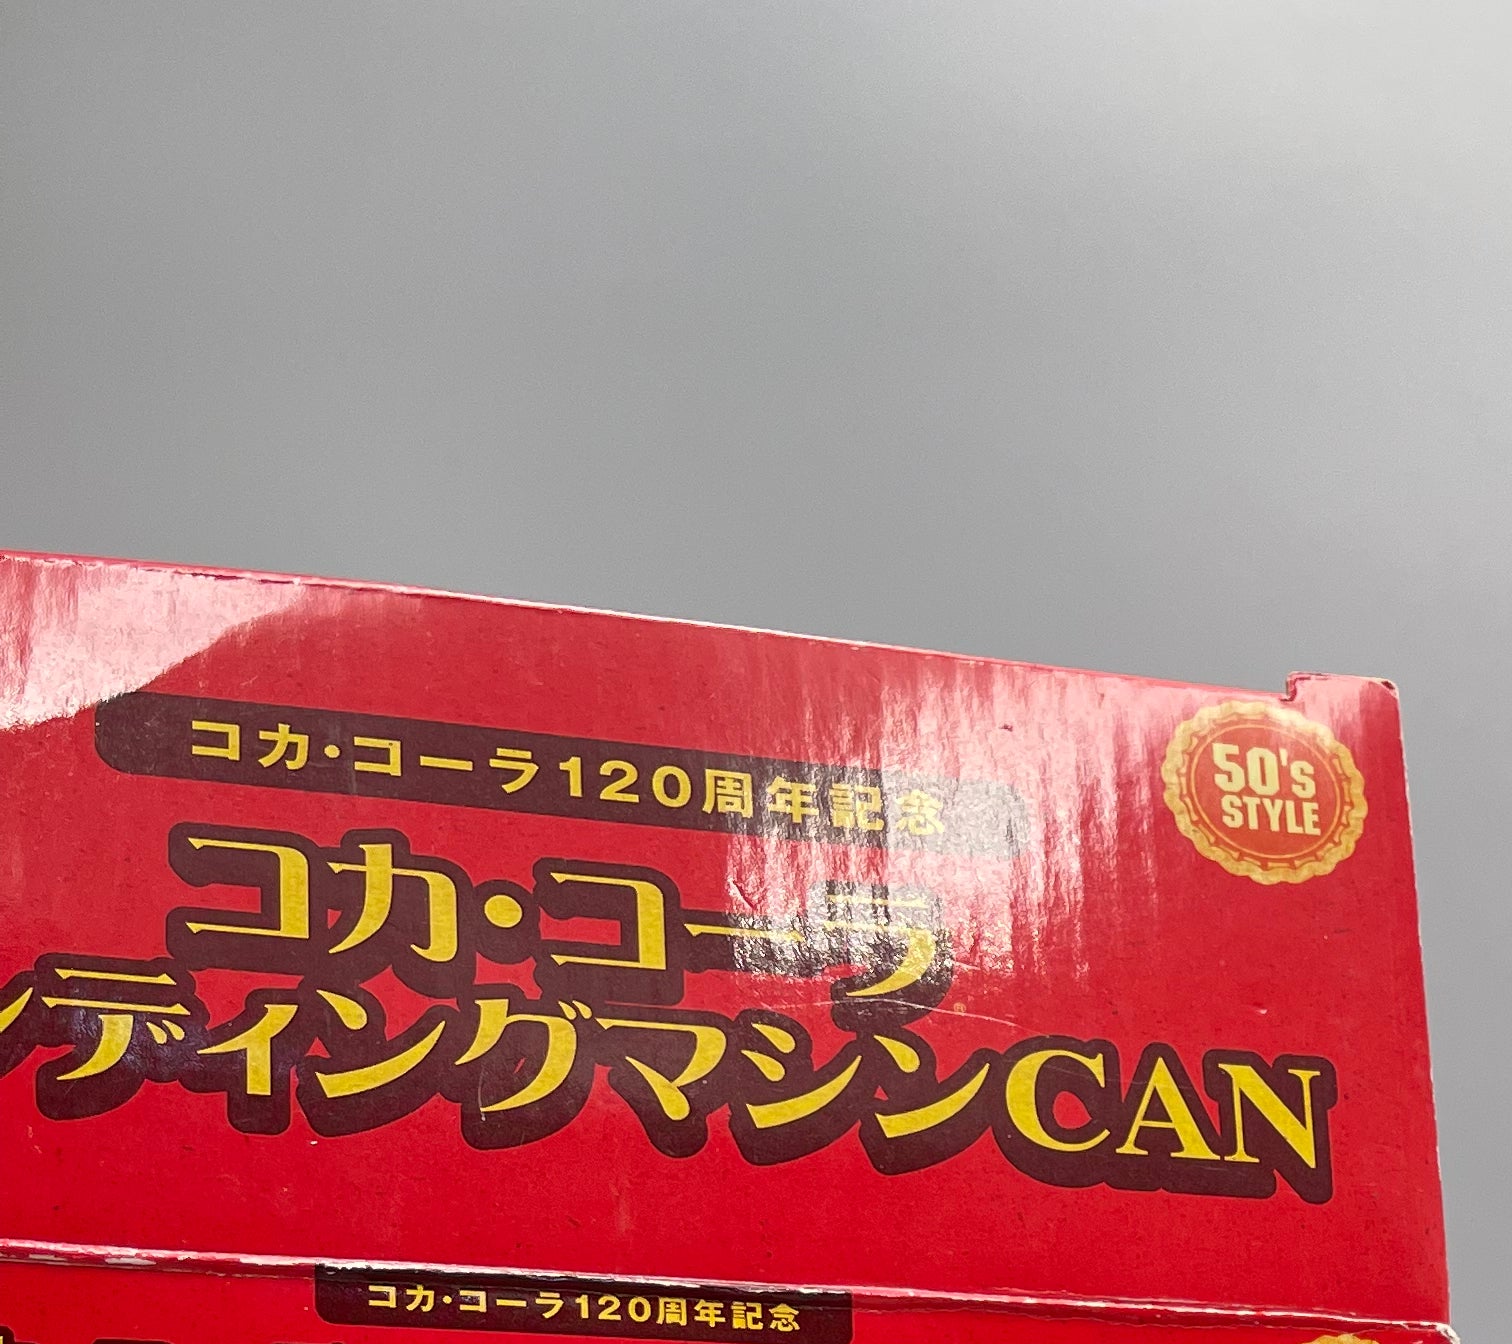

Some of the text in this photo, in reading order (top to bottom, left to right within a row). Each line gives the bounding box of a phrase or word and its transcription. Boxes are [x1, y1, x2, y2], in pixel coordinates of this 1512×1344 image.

[191, 719, 946, 836] コカ・コーラ120周年記念
[1212, 742, 1316, 799] 50's
[1220, 793, 1322, 838] STYLE
[186, 837, 937, 998] コカ・コーラ
[367, 1283, 801, 1333] コカ・コーラ120周年記念
